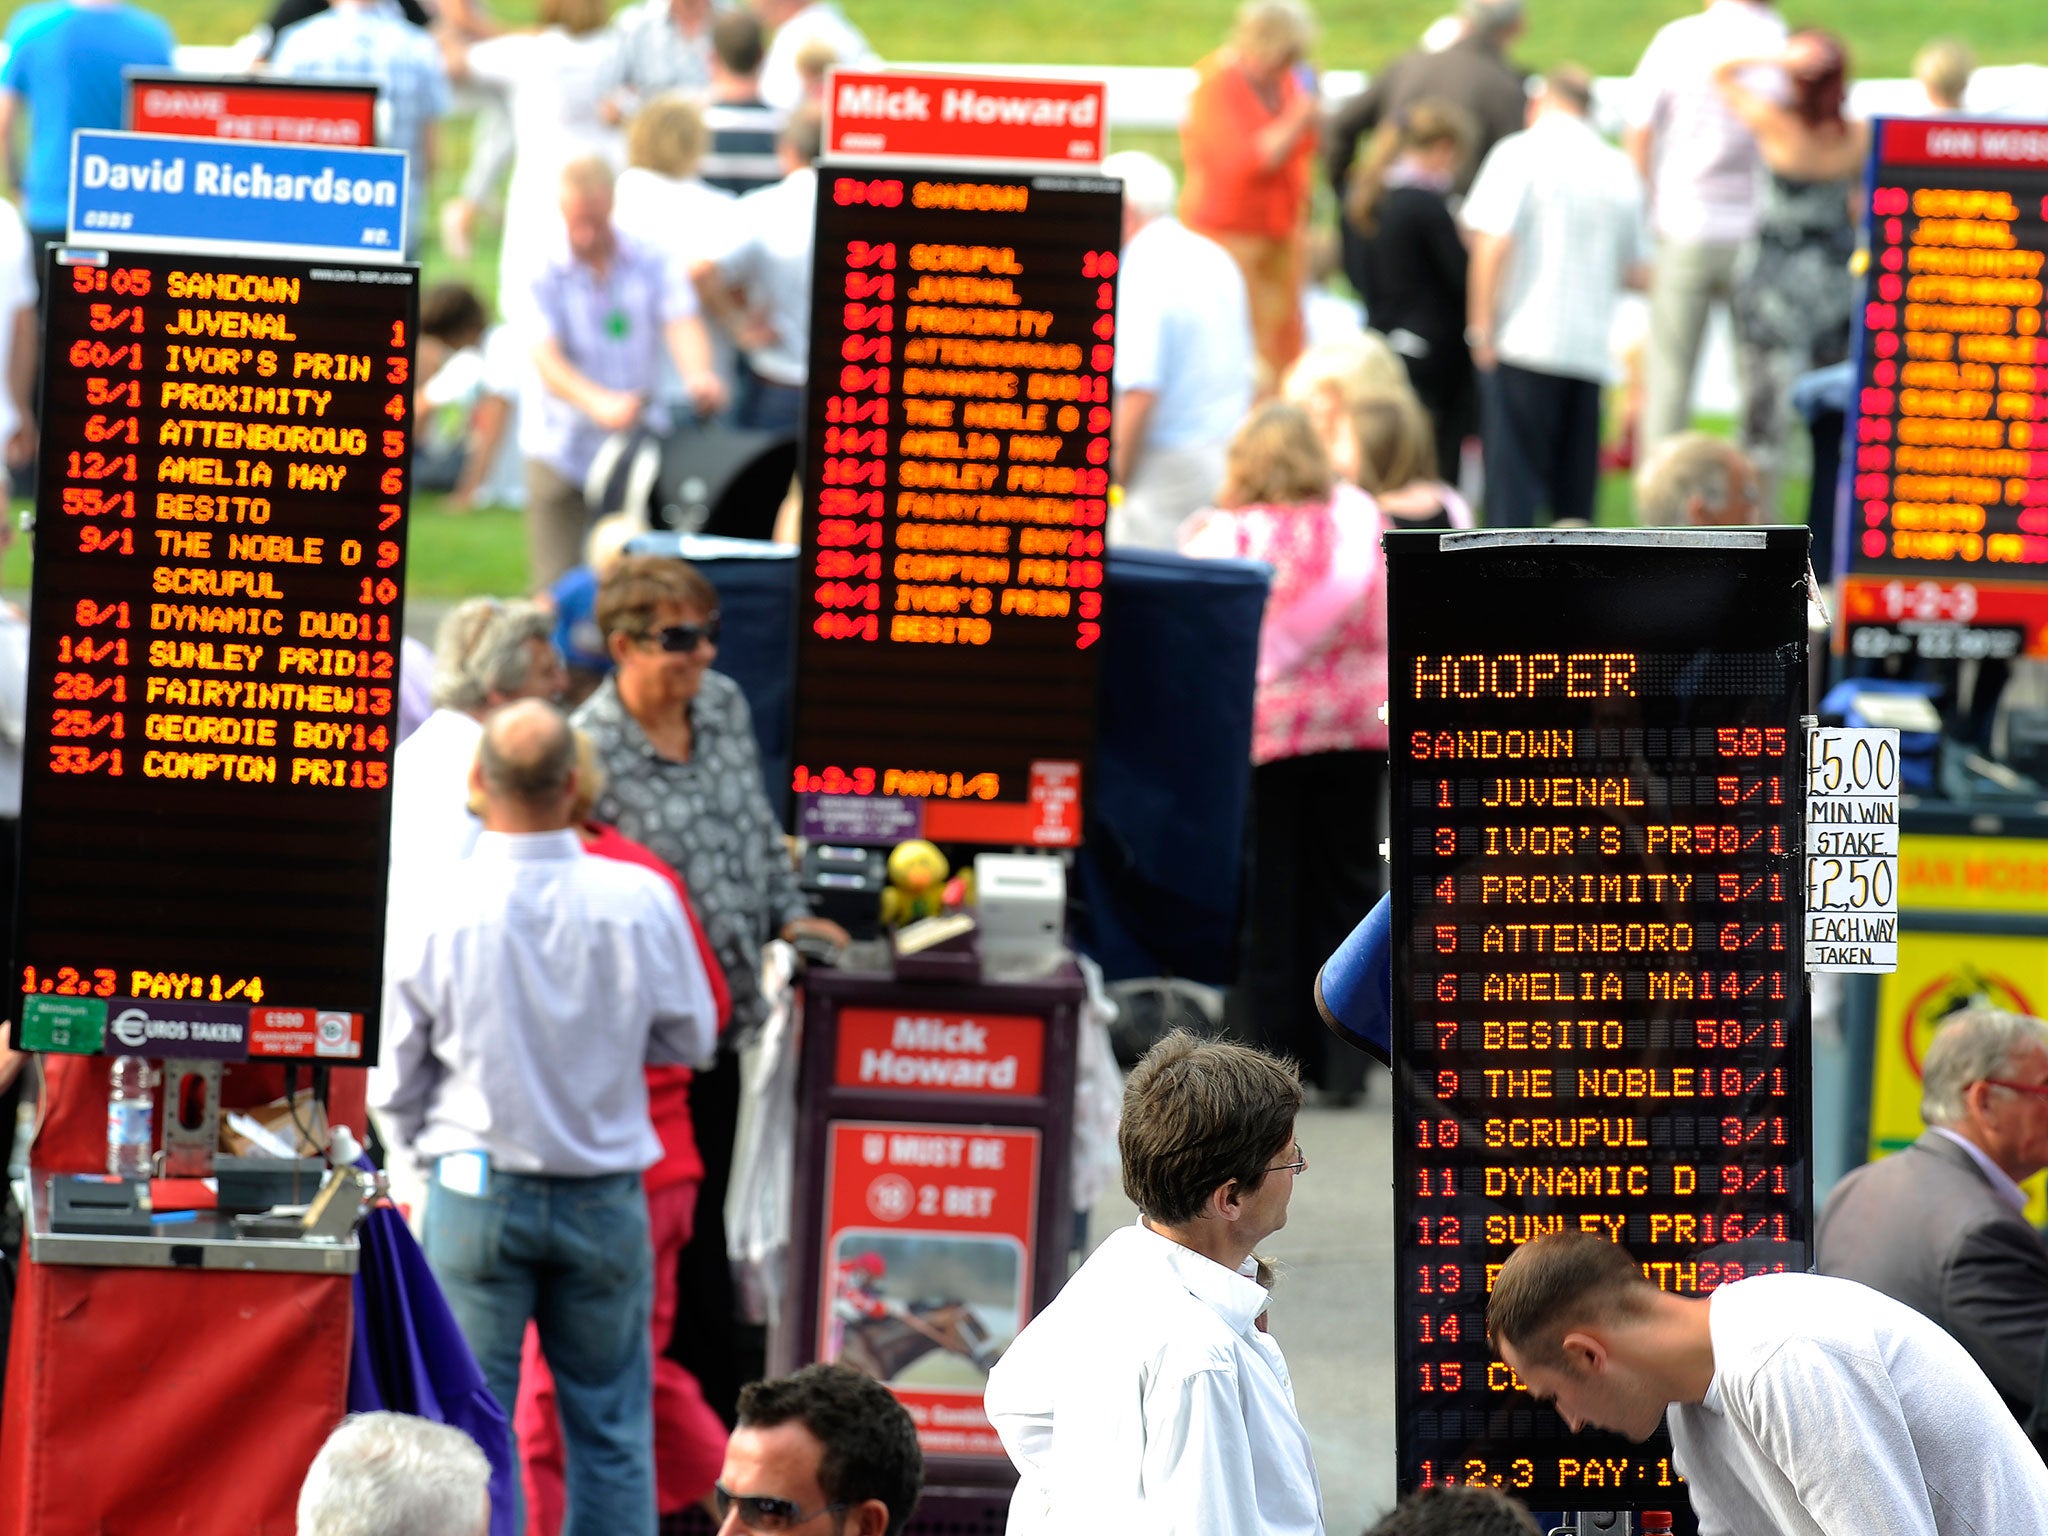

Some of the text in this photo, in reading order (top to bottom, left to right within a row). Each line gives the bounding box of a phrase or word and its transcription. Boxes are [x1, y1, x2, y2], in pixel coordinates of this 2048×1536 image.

[837, 83, 1099, 128] Mick Howard
[83, 154, 397, 208] David Richardson
[73, 263, 300, 304] 5:05 SANDOWN
[90, 303, 406, 348] 5/1 JUVENAL 1
[69, 340, 143, 370] 60/1
[293, 352, 371, 382] PRIN
[386, 357, 408, 384] 3
[86, 377, 406, 421] 5/1 PROXIMITY 4
[84, 414, 405, 458] 6/1 ATTENBOROUG 5
[67, 451, 403, 495] 12/1 AMELIA MAY 6
[63, 488, 401, 531] 55/1 BESITO 7
[79, 525, 134, 555] 9/1
[155, 530, 212, 558] THE
[228, 534, 324, 564] NOBLE
[376, 541, 400, 568] 9
[152, 567, 398, 605] SCRUPUL 10
[76, 599, 391, 642] 8/1 DYNAMIC DUO 11
[58, 635, 394, 679] 14/1 SUNLEY PRID 12
[1415, 653, 1636, 699] HOOPER
[53, 672, 392, 716] 28/1 FAIRYINTHEW 13
[51, 709, 389, 752] 25/1 GEORDIE BOY 14
[1411, 730, 1573, 759] SANDOWN
[50, 745, 388, 789] 33/1 COMPTON PRI 15
[1438, 776, 1783, 808] 1 JUVENAL 5/1
[1435, 825, 1784, 856] 3 IVOR'S PR 50/1
[1436, 873, 1783, 904] 4 PROXIMITY 5/1
[1436, 923, 1784, 953] 5 ATTENBORO 6/1
[131, 971, 264, 1003] PAY:1/4
[1437, 972, 1784, 1002] 6 AMELIA MA 14/1
[191, 1021, 244, 1042] TAKEN
[892, 1016, 988, 1055] Mick
[1436, 1019, 1785, 1050] 7 BESITO 50/1
[859, 1050, 1018, 1090] Howard
[1437, 1068, 1785, 1098] 9 THE NOBLE 10/1
[1418, 1117, 1786, 1148] 10 SCRUPUL 3/1
[862, 1135, 1006, 1171] U MUST BE
[1418, 1165, 1787, 1196] 11 DYNAMIC D 9/1
[918, 1187, 940, 1216] 2
[942, 1188, 997, 1219] BET
[1419, 1216, 1460, 1245] 12
[1650, 1214, 1696, 1243] PR
[1701, 1214, 1788, 1243] 16/1
[1419, 1264, 1460, 1294] 13
[1420, 1314, 1460, 1343] 14
[1420, 1362, 1462, 1392] 15
